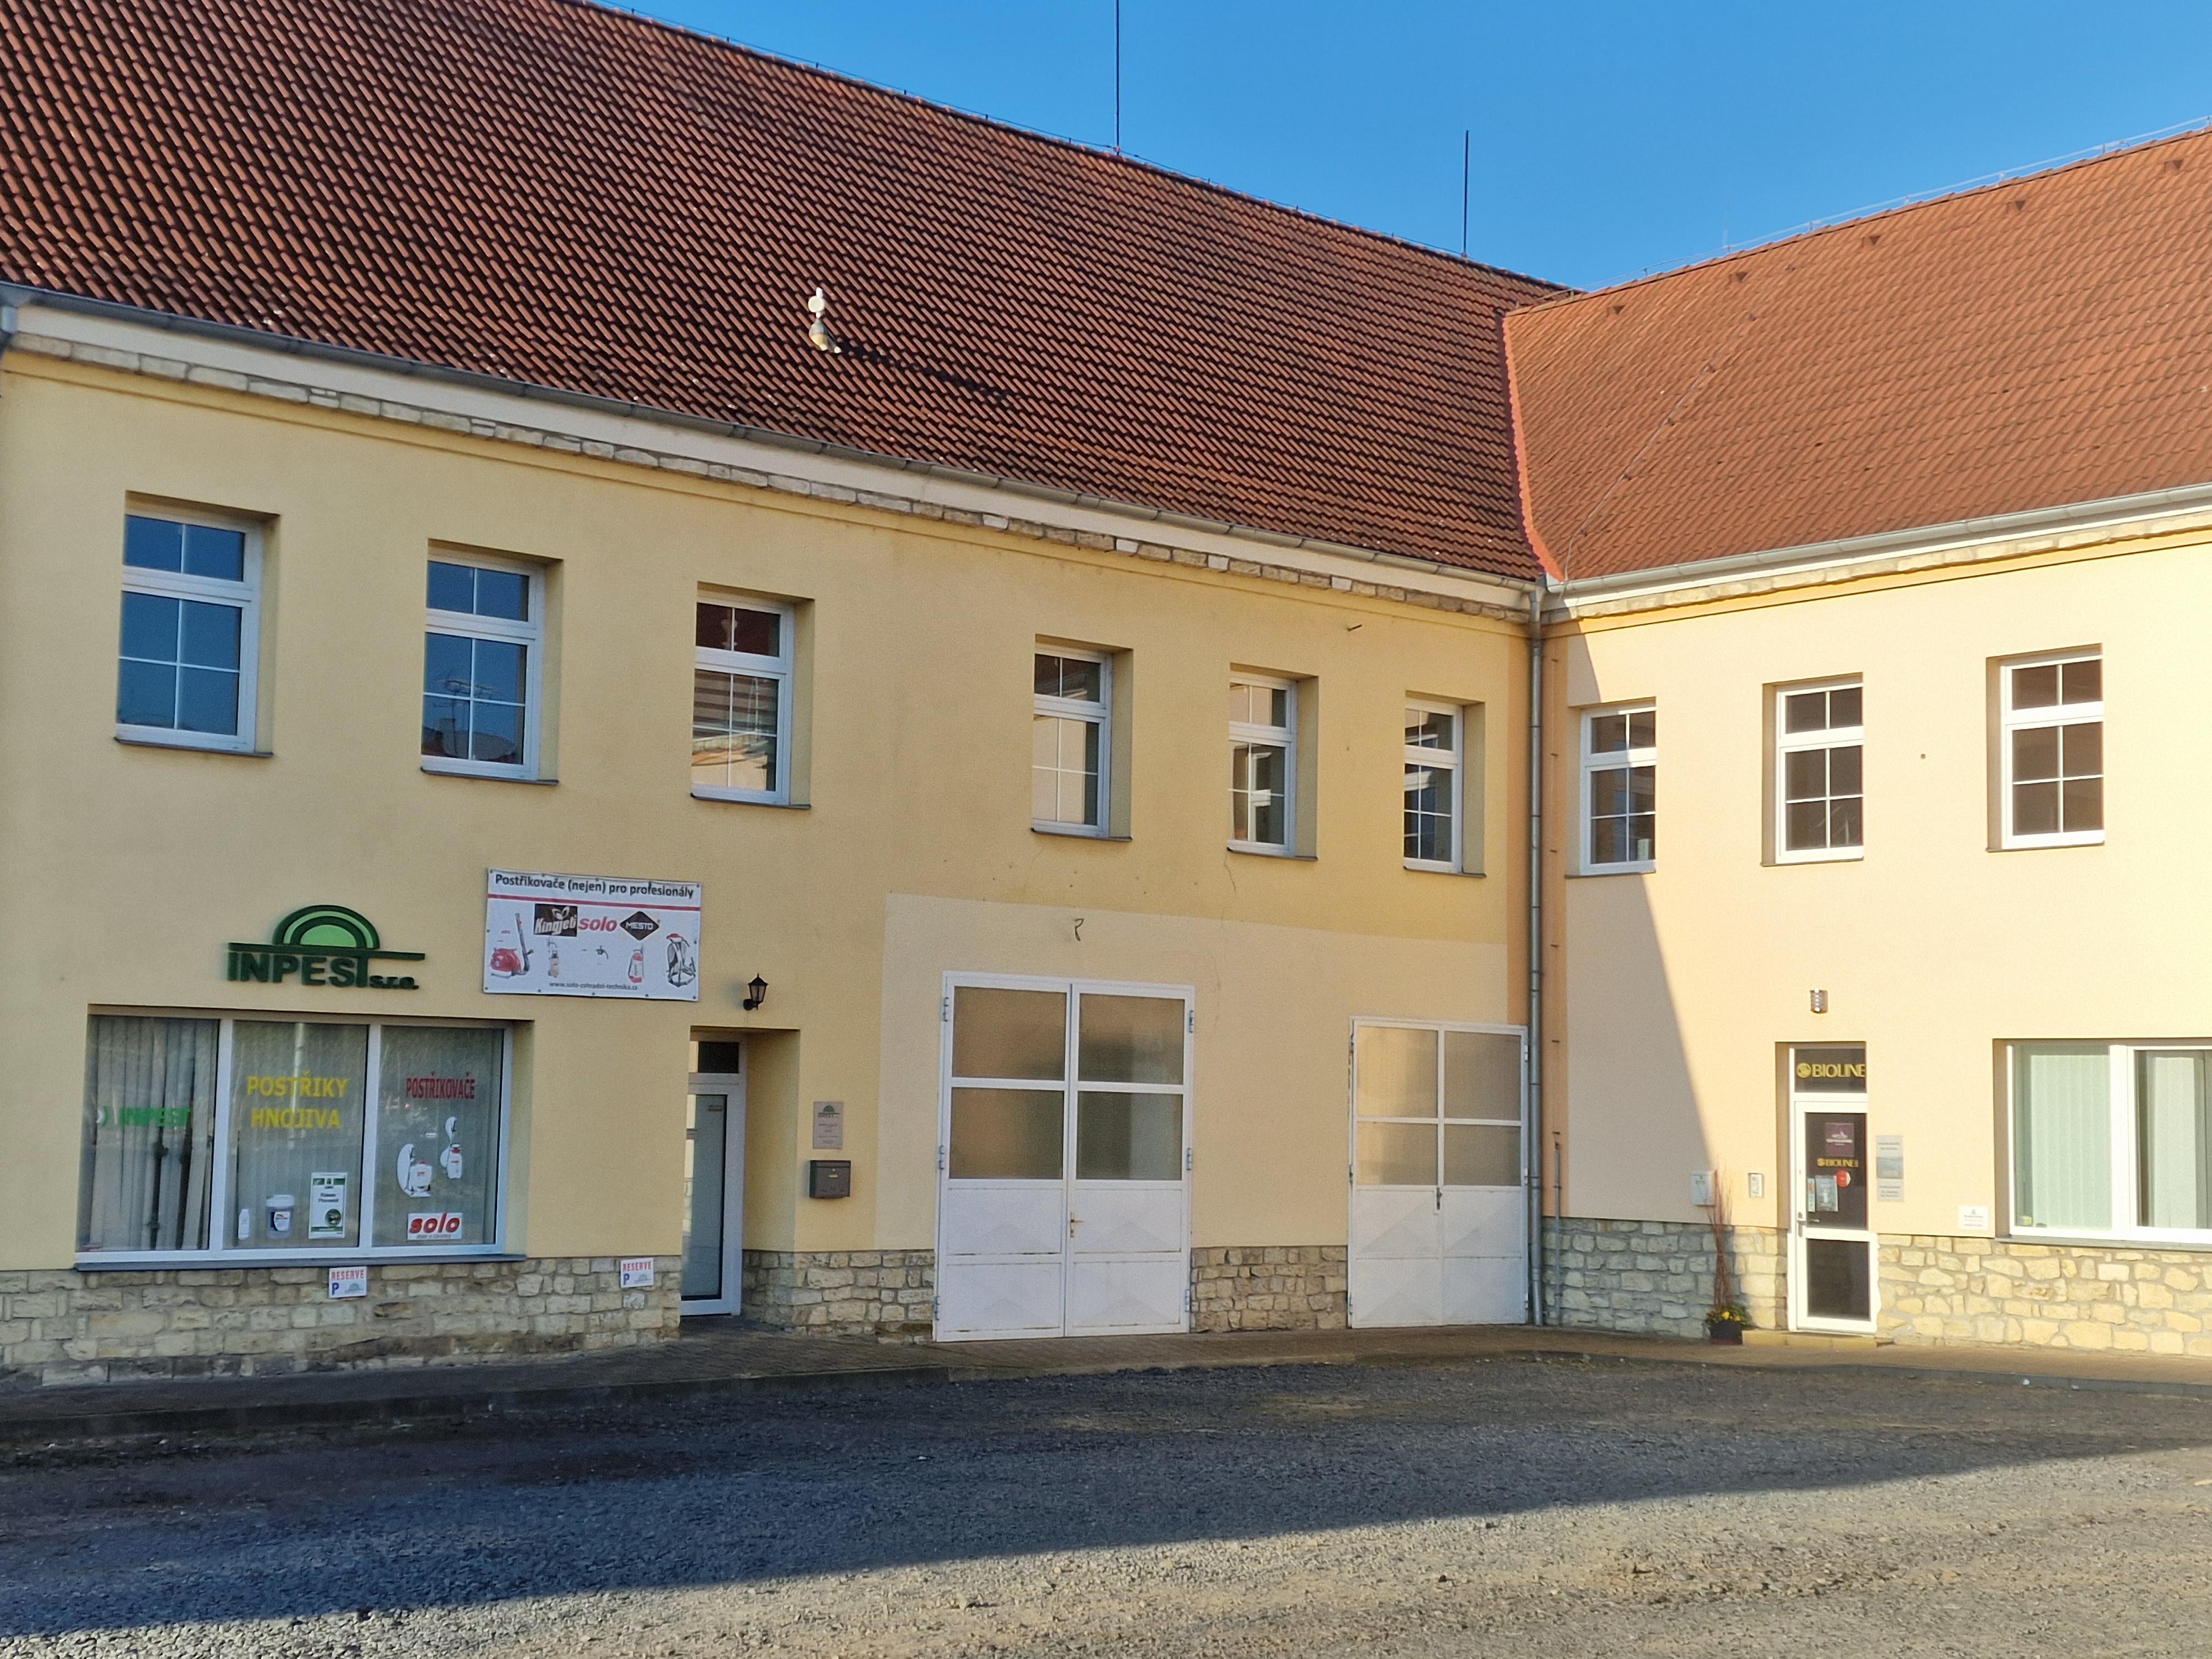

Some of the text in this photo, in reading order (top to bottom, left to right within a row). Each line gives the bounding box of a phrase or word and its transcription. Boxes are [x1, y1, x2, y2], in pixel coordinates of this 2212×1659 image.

[495, 874, 693, 900] Postřikovače (nejen) pro profesionály
[578, 916, 617, 932] solo
[625, 922, 654, 930] MESTO
[227, 951, 419, 990] INPEST s.r.o.
[1812, 1063, 1866, 1078] BIOLINE
[247, 1071, 349, 1098] POSTŘIKY
[406, 1071, 476, 1099] POSTŘIKOVAČE
[251, 1108, 342, 1129] HNOJIVA
[409, 1212, 460, 1234] solo
[623, 1261, 651, 1271] RESERVE
[332, 1270, 364, 1281] RESERVE
[623, 1274, 630, 1286] P
[332, 1282, 340, 1296] P
